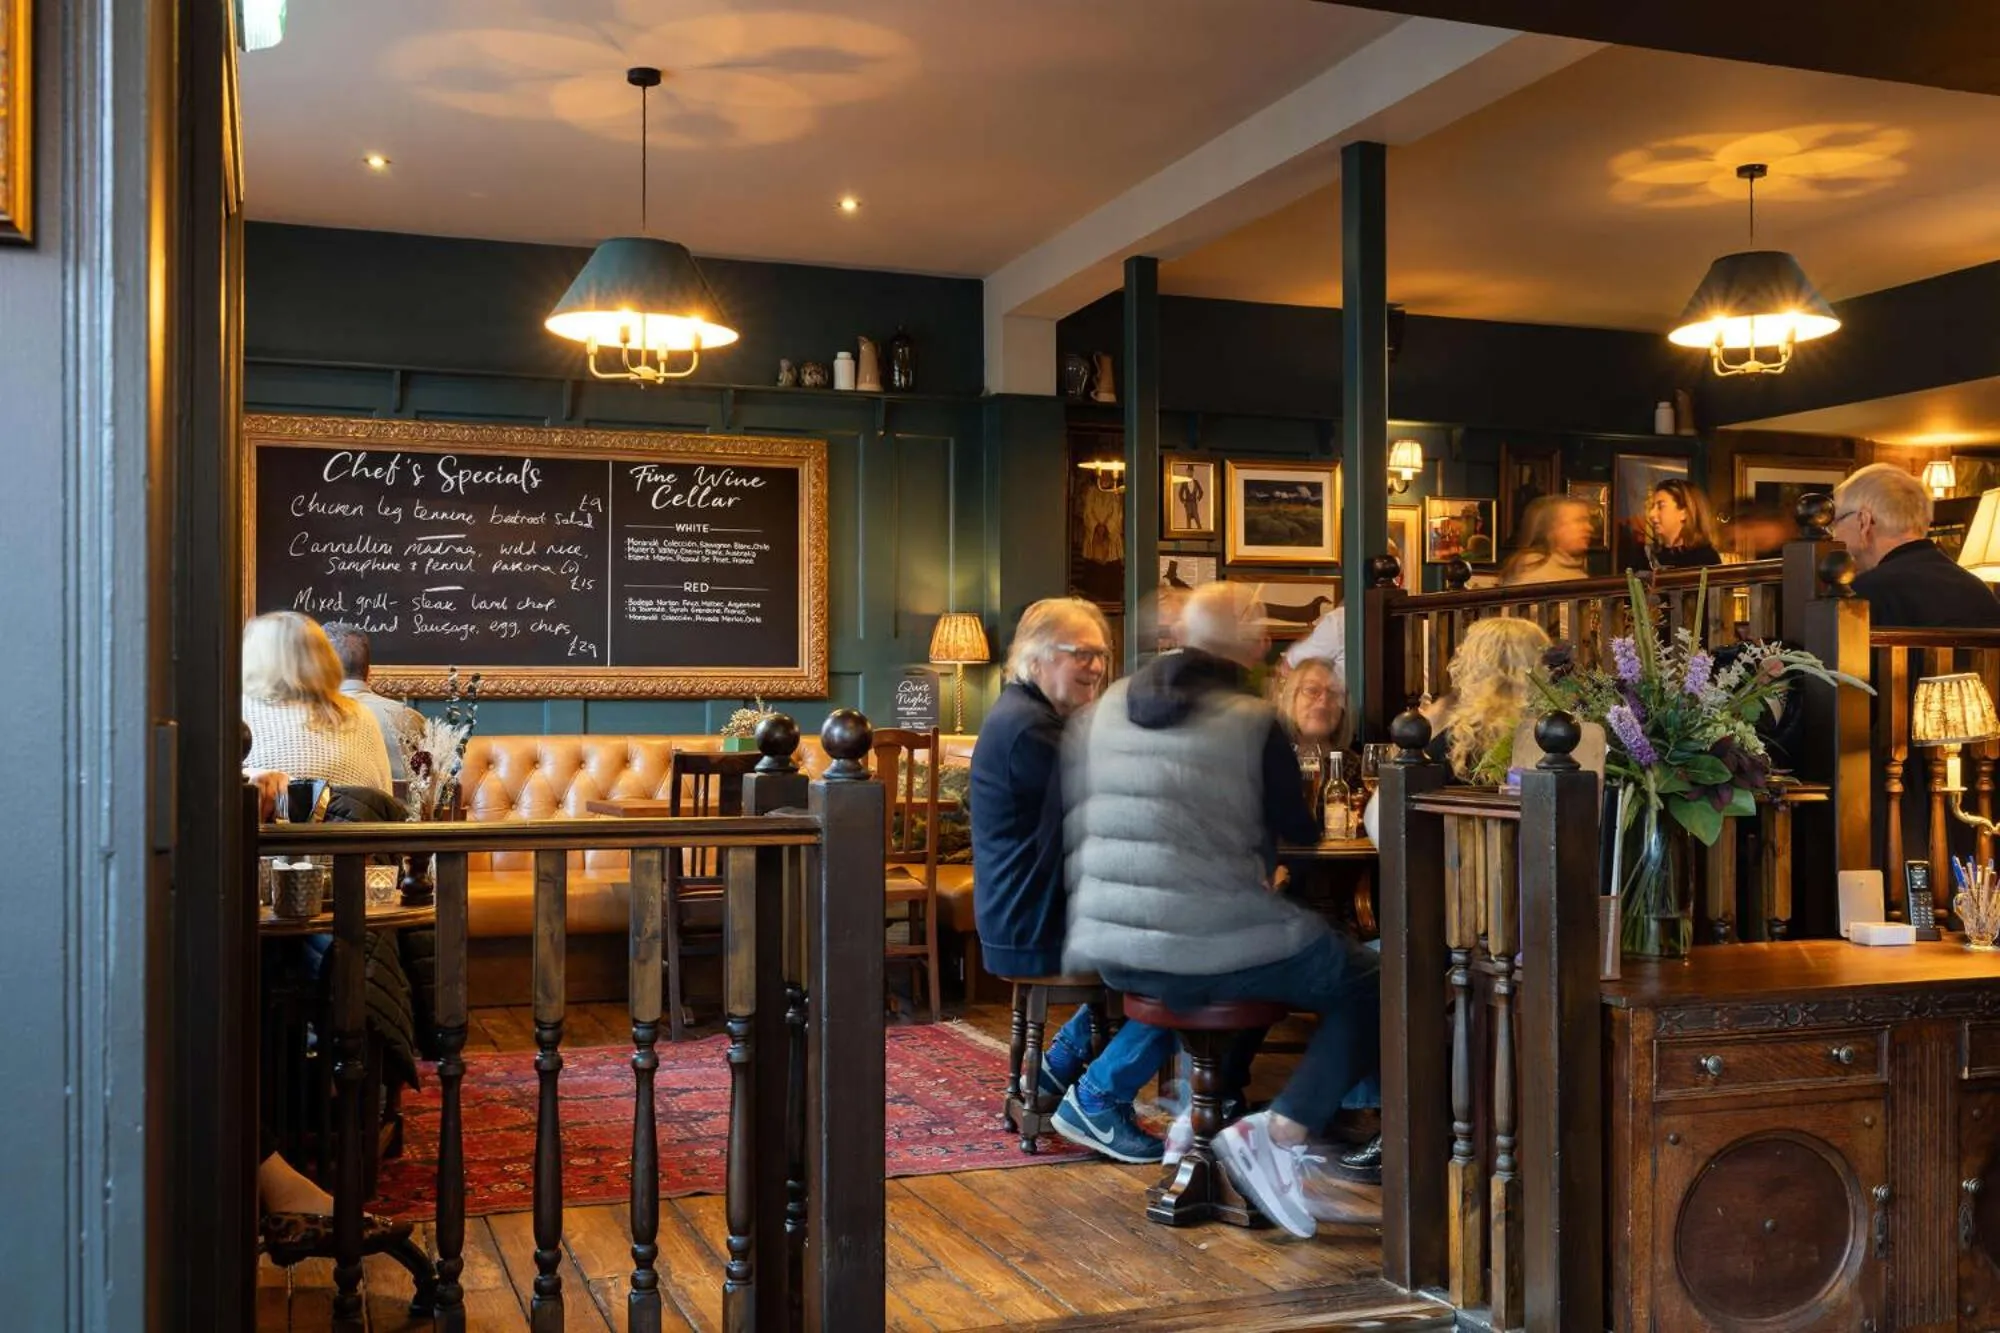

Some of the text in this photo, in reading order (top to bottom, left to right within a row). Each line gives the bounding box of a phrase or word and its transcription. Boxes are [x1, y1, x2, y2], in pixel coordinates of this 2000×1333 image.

[323, 451, 542, 495] Chef's Specials
[629, 464, 767, 492] Fine Wine
[291, 492, 364, 517] Chicken
[378, 495, 402, 524] leg
[414, 498, 476, 525] terrine
[651, 484, 741, 510] Cellar
[675, 523, 710, 533] WHITE
[289, 531, 393, 557] Cannellini
[500, 540, 536, 556] wild
[325, 556, 402, 579] Samphire
[570, 575, 596, 592] £15
[683, 581, 710, 593] RED
[293, 586, 348, 612] Mixed
[567, 634, 598, 659] £29
[896, 692, 933, 707] Night
